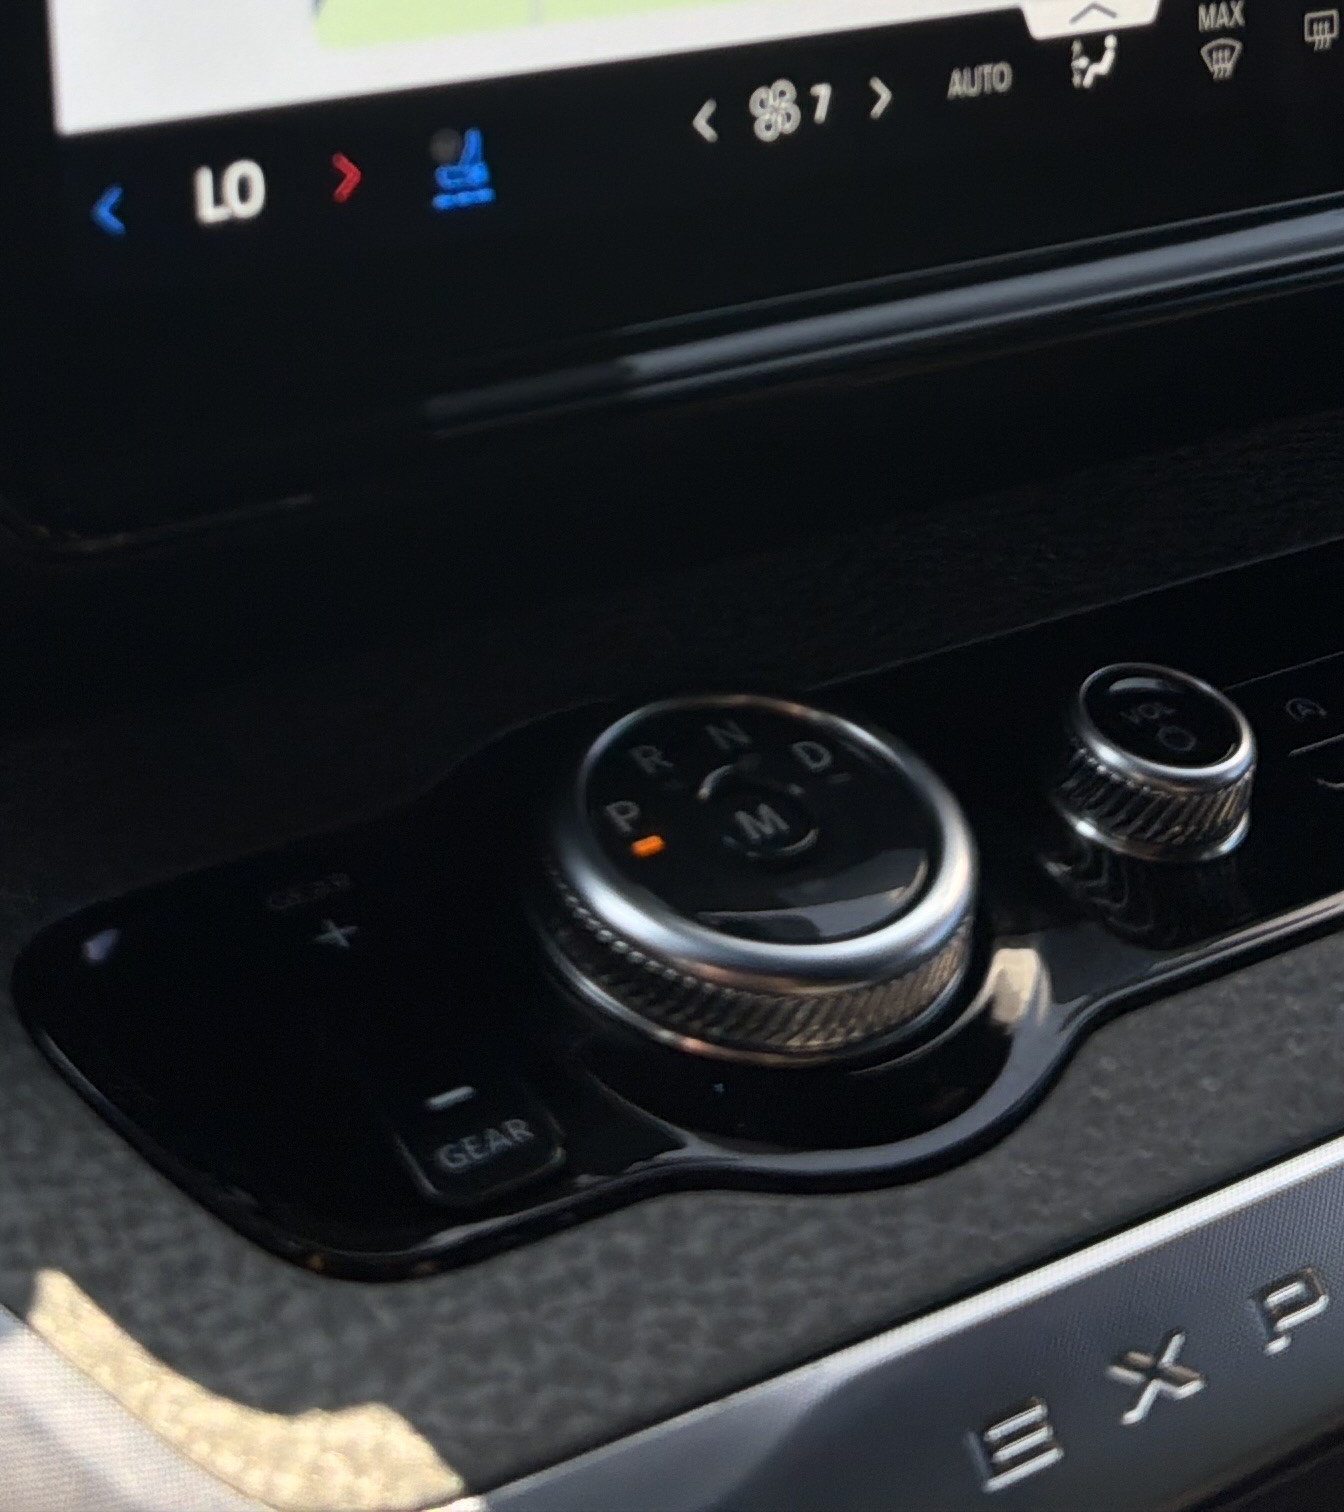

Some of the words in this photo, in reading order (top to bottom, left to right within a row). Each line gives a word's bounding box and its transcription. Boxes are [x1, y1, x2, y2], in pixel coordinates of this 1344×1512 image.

[947, 61, 1014, 101] AUTO
[192, 158, 267, 228] LO
[604, 799, 641, 833] P
[629, 744, 674, 775] R
[705, 719, 752, 751] N
[791, 740, 832, 772] D
[734, 803, 790, 841] M
[436, 1117, 535, 1171] GEAR
